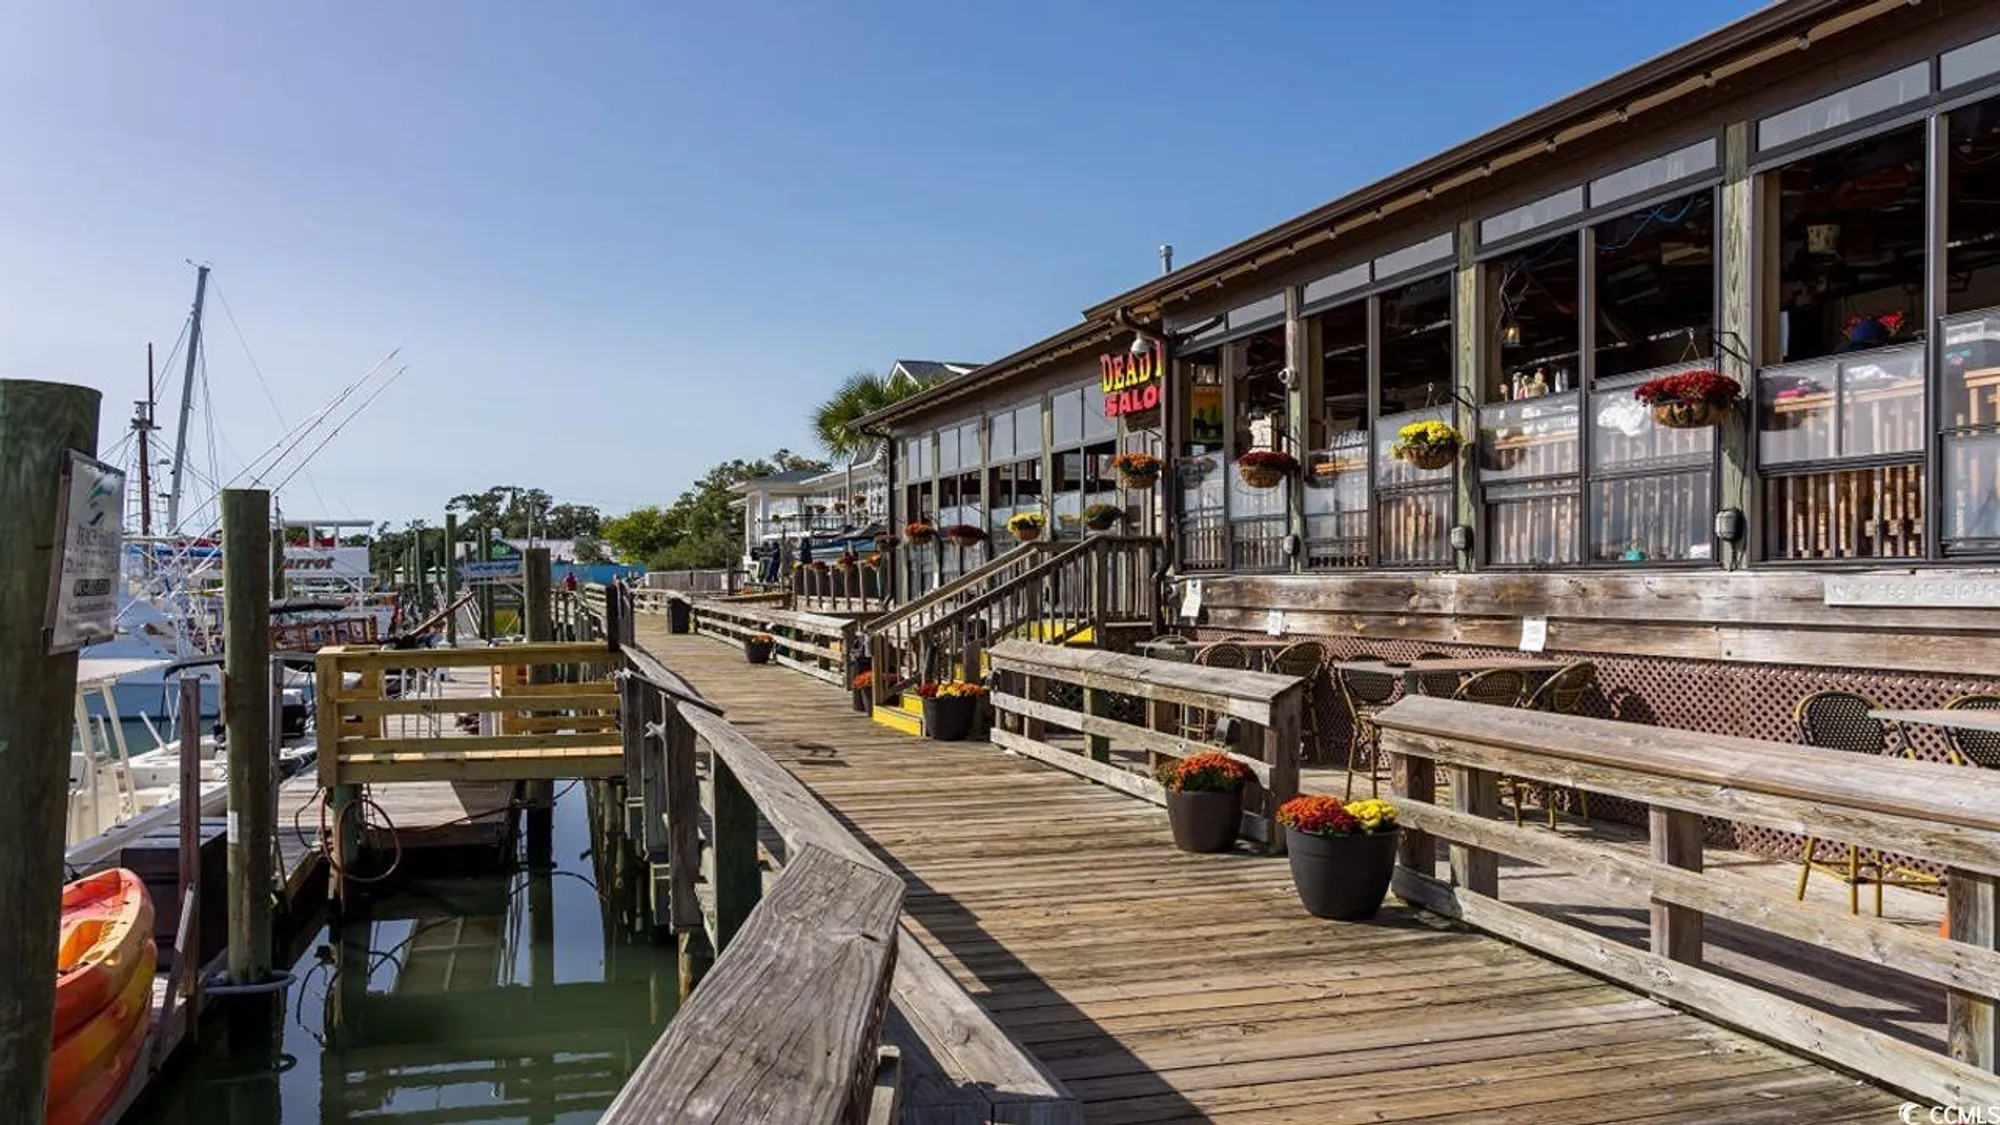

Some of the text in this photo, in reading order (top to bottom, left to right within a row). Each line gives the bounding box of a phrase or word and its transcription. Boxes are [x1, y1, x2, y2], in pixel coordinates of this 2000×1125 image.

[1100, 351, 1152, 393] DEAD
[1104, 384, 1163, 418] SALO
[284, 556, 335, 570] arrot
